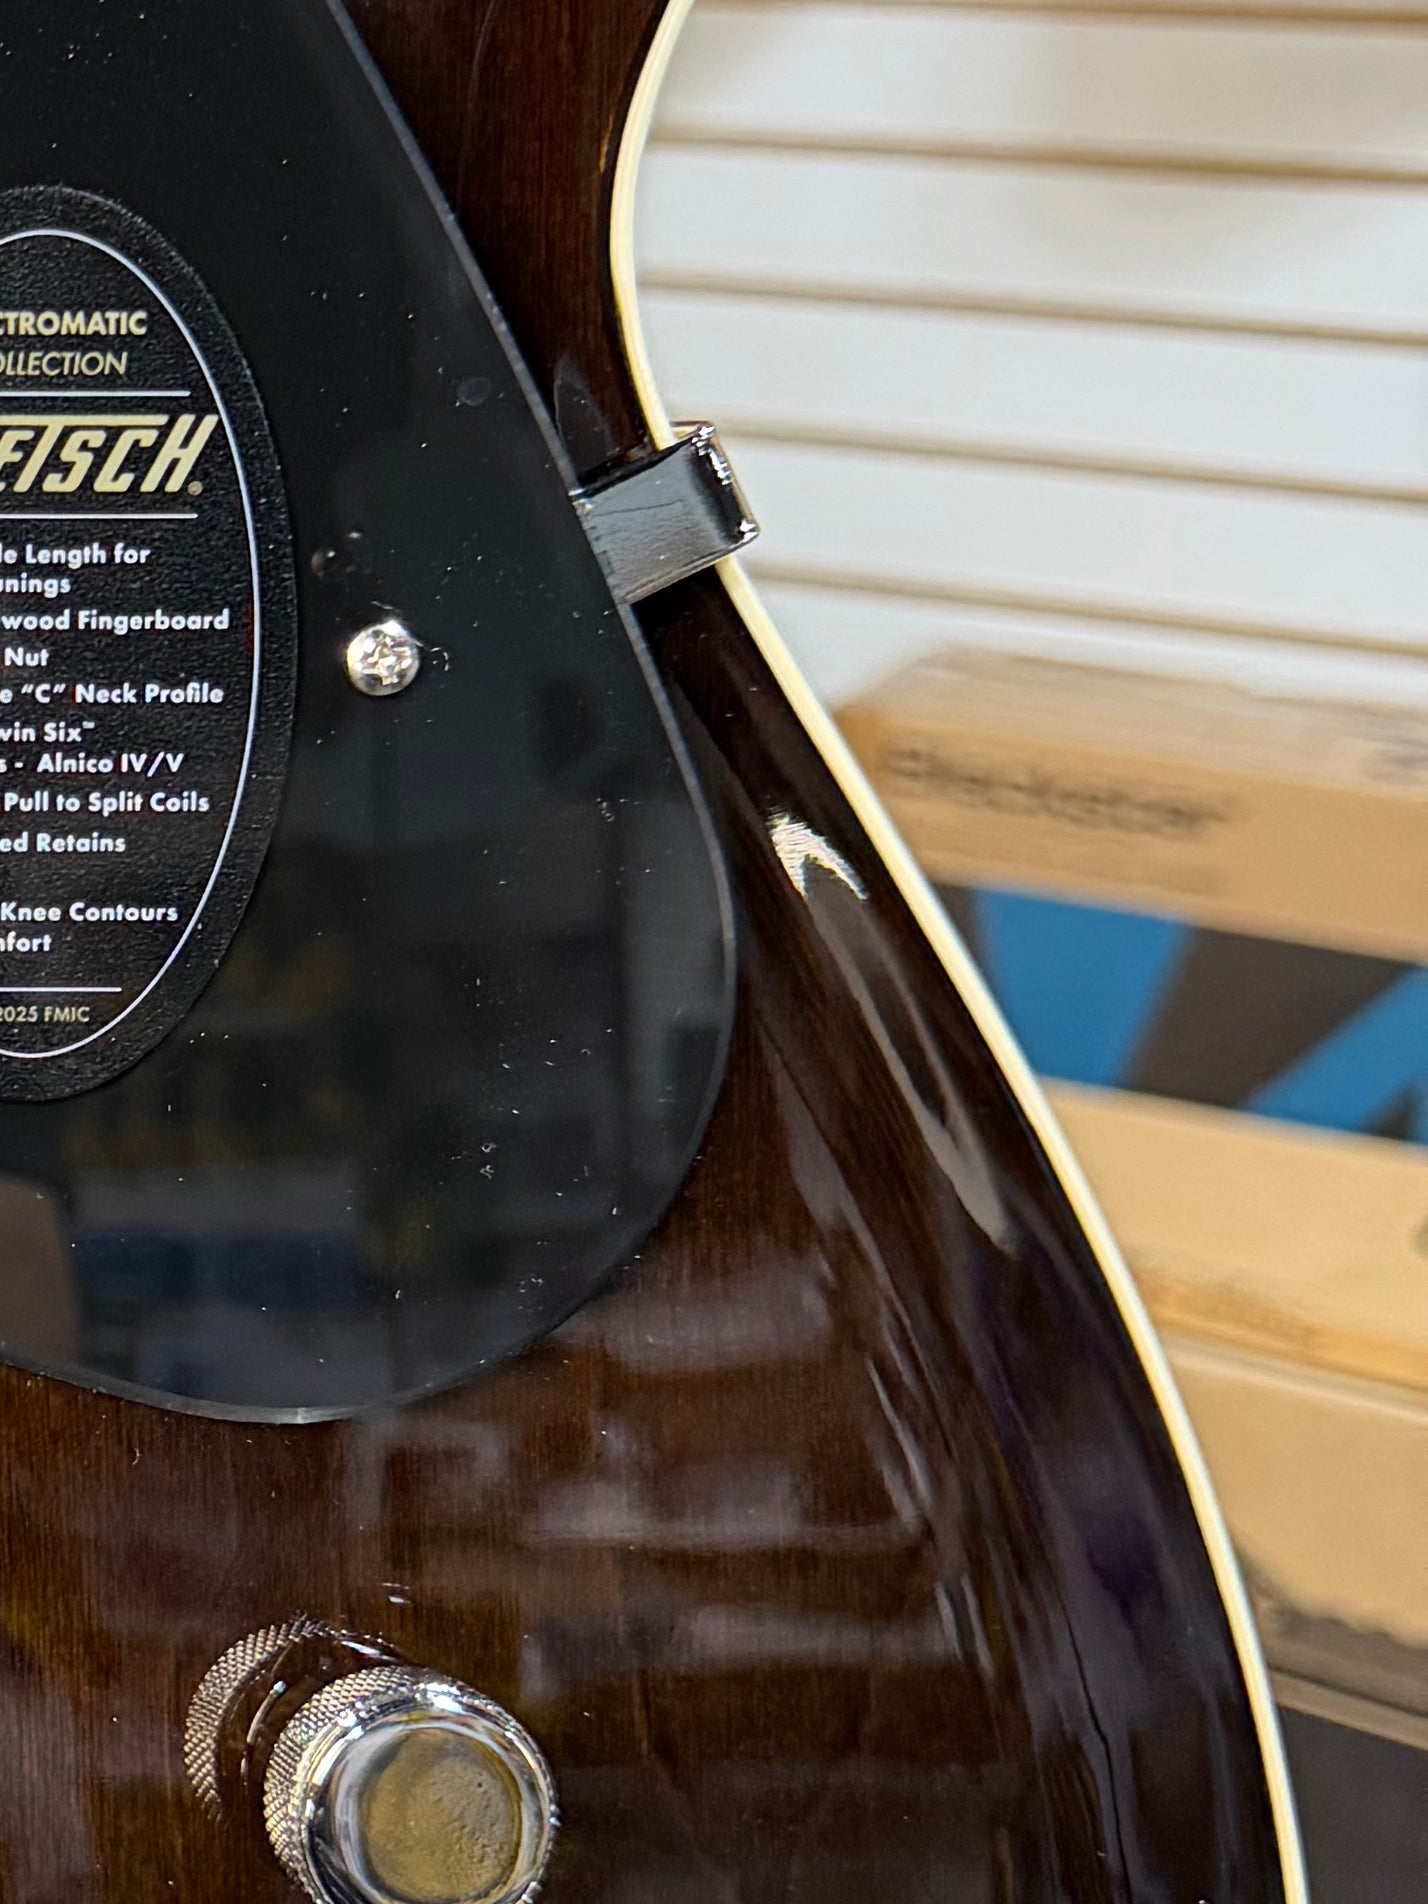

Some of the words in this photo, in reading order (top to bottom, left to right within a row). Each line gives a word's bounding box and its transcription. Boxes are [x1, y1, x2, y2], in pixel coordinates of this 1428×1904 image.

[25, 543, 107, 569] Length
[114, 543, 151, 564] for
[78, 609, 230, 635] Fingerboard
[4, 647, 50, 667] Nut
[75, 683, 137, 704] Neck
[144, 683, 224, 704] Profile
[37, 752, 114, 773] Alnico
[120, 752, 184, 777] IV/V
[4, 792, 49, 813] Pull
[56, 793, 80, 813] to
[88, 792, 143, 817] Split
[150, 792, 210, 813] Coils
[36, 833, 126, 853] Retains
[0, 902, 61, 922] Knee
[69, 902, 178, 922] Contours
[44, 1006, 90, 1022] FMIC
